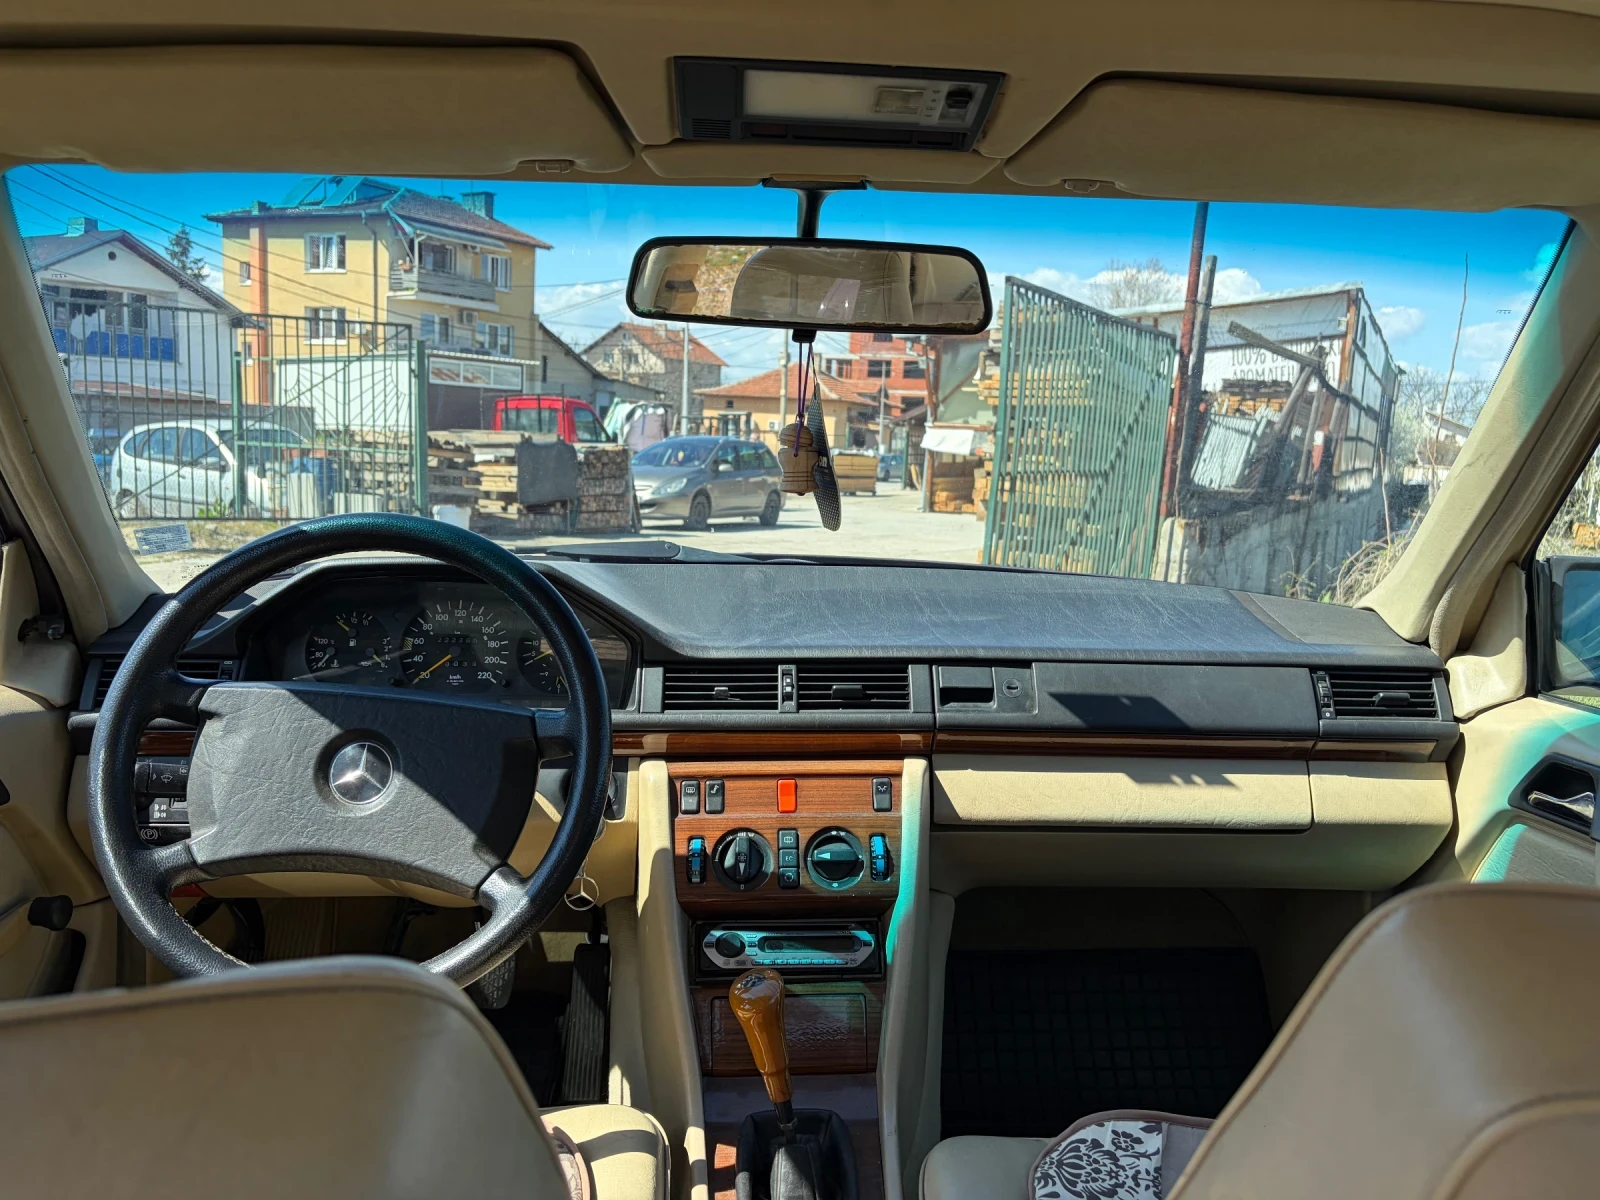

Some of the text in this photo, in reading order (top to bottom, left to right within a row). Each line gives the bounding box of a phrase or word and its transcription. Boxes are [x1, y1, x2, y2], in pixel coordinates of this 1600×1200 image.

[1231, 346, 1267, 366] 100%
[435, 613, 449, 621] 100
[454, 609, 467, 617] 120
[471, 615, 484, 623] 140
[422, 623, 433, 631] 80
[481, 626, 495, 634] 160
[413, 637, 425, 645] 60
[487, 640, 500, 648] 180
[413, 654, 424, 662] 40
[484, 656, 500, 664] 200
[419, 671, 431, 679] 20
[477, 671, 492, 679] 220
[785, 854, 794, 862] EC
